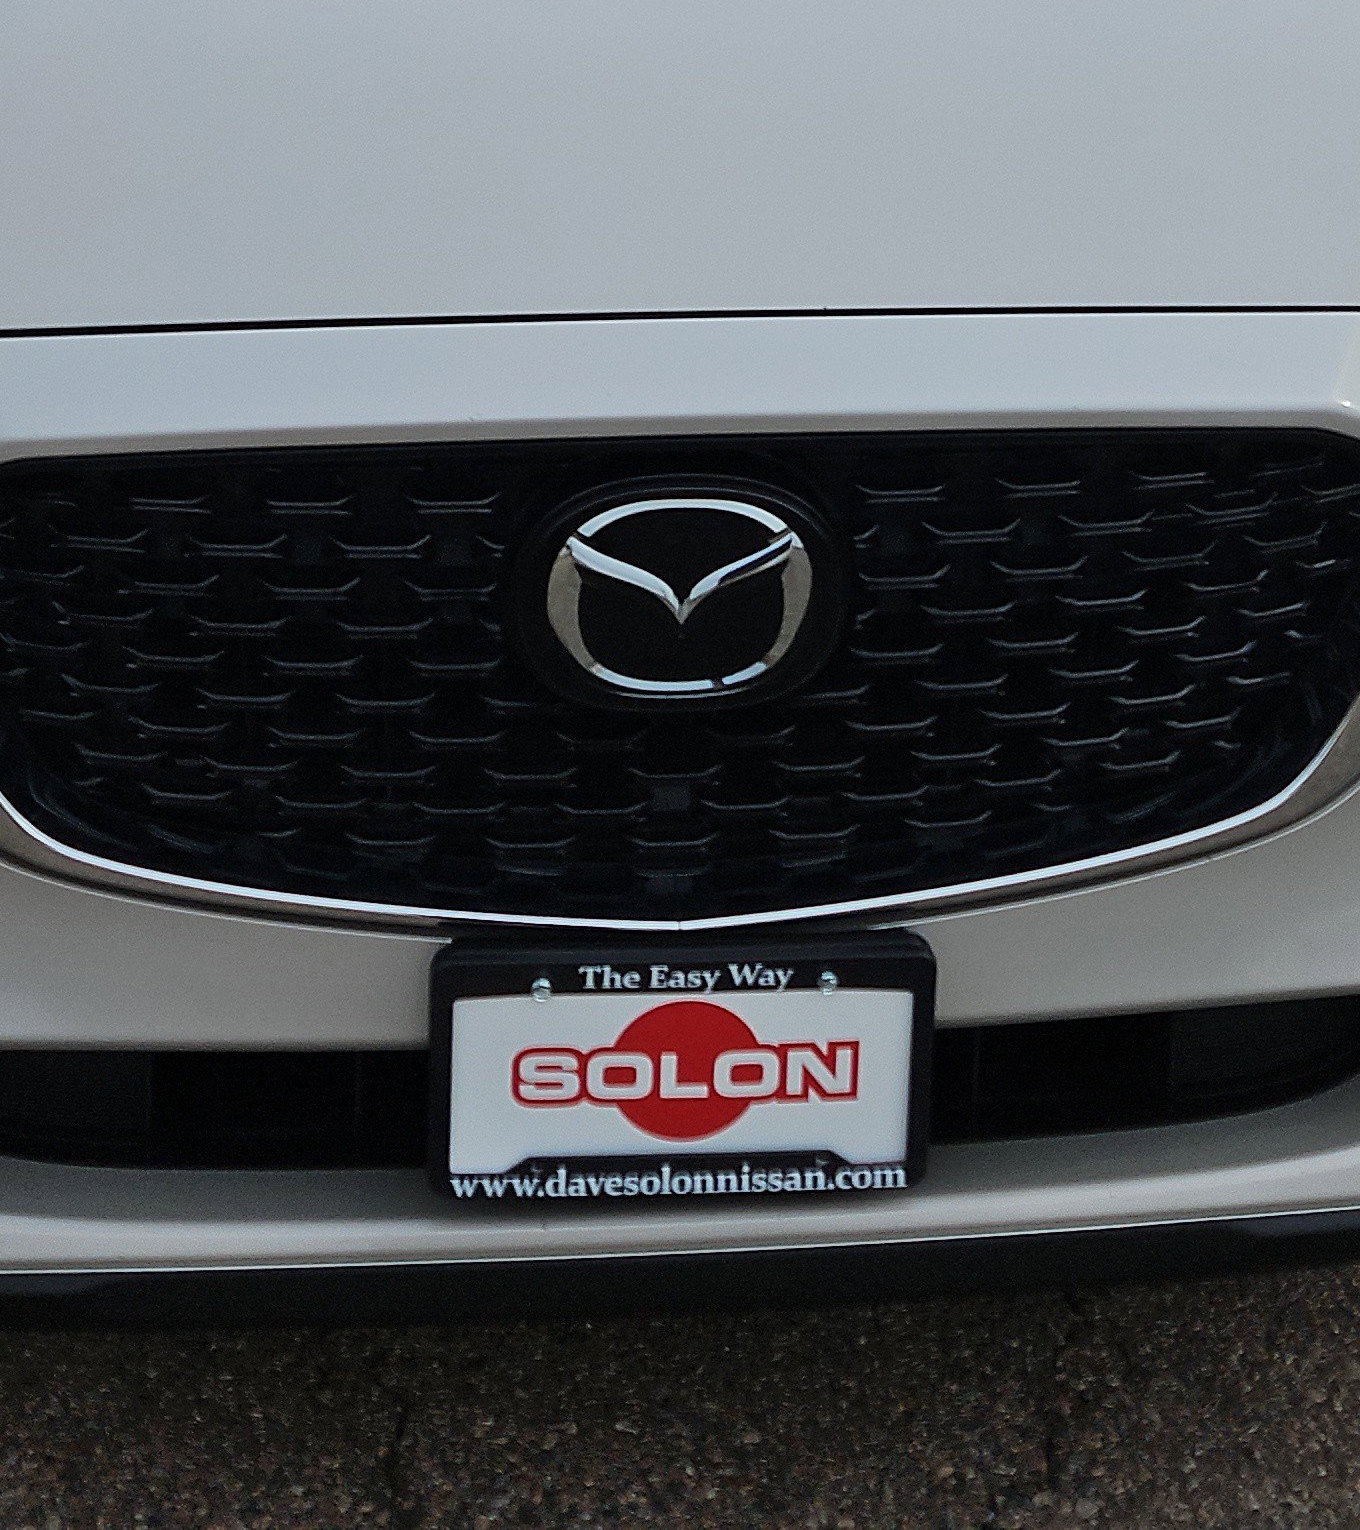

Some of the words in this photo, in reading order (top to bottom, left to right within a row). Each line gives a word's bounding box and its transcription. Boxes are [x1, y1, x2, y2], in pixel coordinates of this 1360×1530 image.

[579, 965, 640, 991] The
[649, 965, 720, 993] Easy
[728, 963, 794, 992] Way
[512, 1042, 860, 1107] SOLON
[450, 1164, 908, 1199] www.davesolonnissan.com
